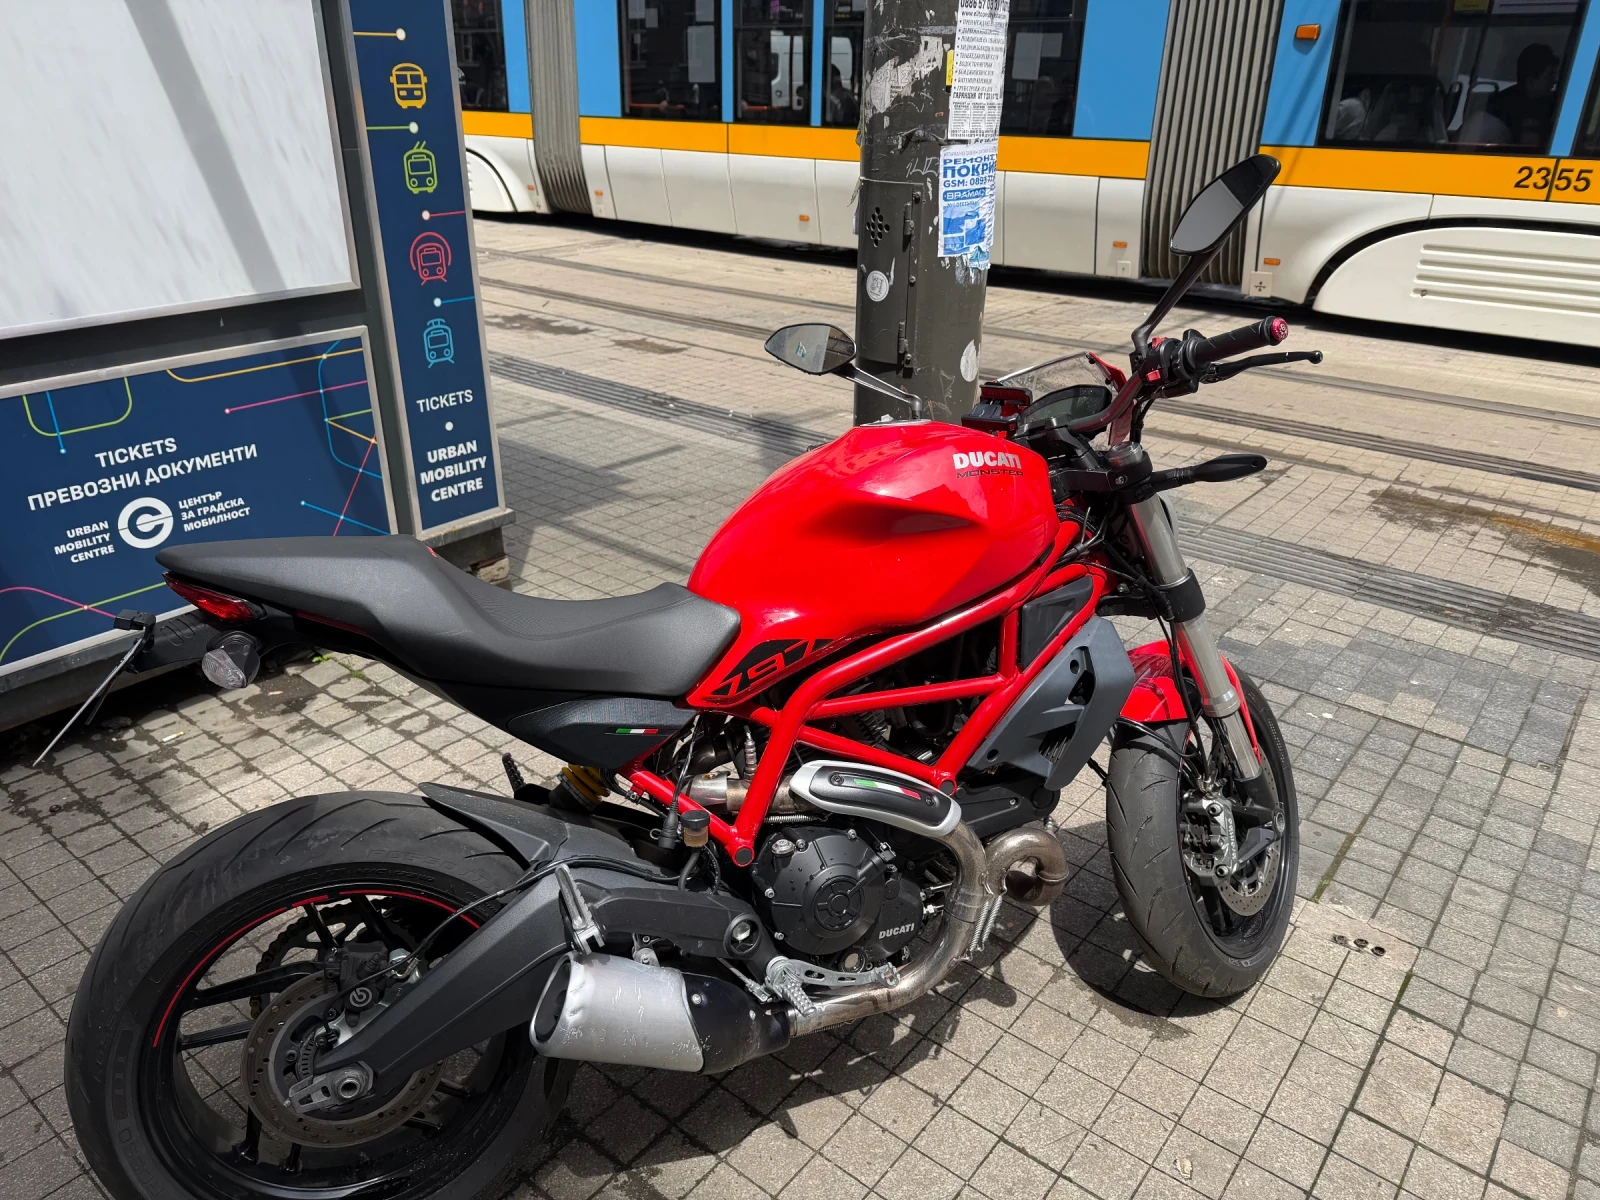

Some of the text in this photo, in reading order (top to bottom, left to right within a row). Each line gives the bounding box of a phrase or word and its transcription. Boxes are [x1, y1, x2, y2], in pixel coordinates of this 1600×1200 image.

[943, 179, 968, 188] GSM:
[1514, 166, 1593, 192] 2355
[416, 389, 473, 413] TICKETS
[95, 437, 177, 468] TICKETS
[427, 440, 478, 463] URBAN
[952, 451, 1022, 469] DUCATI
[27, 444, 258, 511] ПРЕВОЗНИ ДОКУМЕНТИ
[420, 456, 487, 485] MOBILITY
[956, 469, 1024, 478] MONSTER
[178, 491, 222, 510] ЦЕНТЪР
[431, 477, 483, 502] CENTRE
[181, 497, 245, 521] ЗА ГРАДСКА
[183, 507, 251, 532] МОБИЛНОСТ
[66, 520, 109, 539] URBAN
[54, 533, 111, 555] MOBILITY
[70, 544, 115, 563] CENTRE
[878, 923, 915, 939] DUCATI
